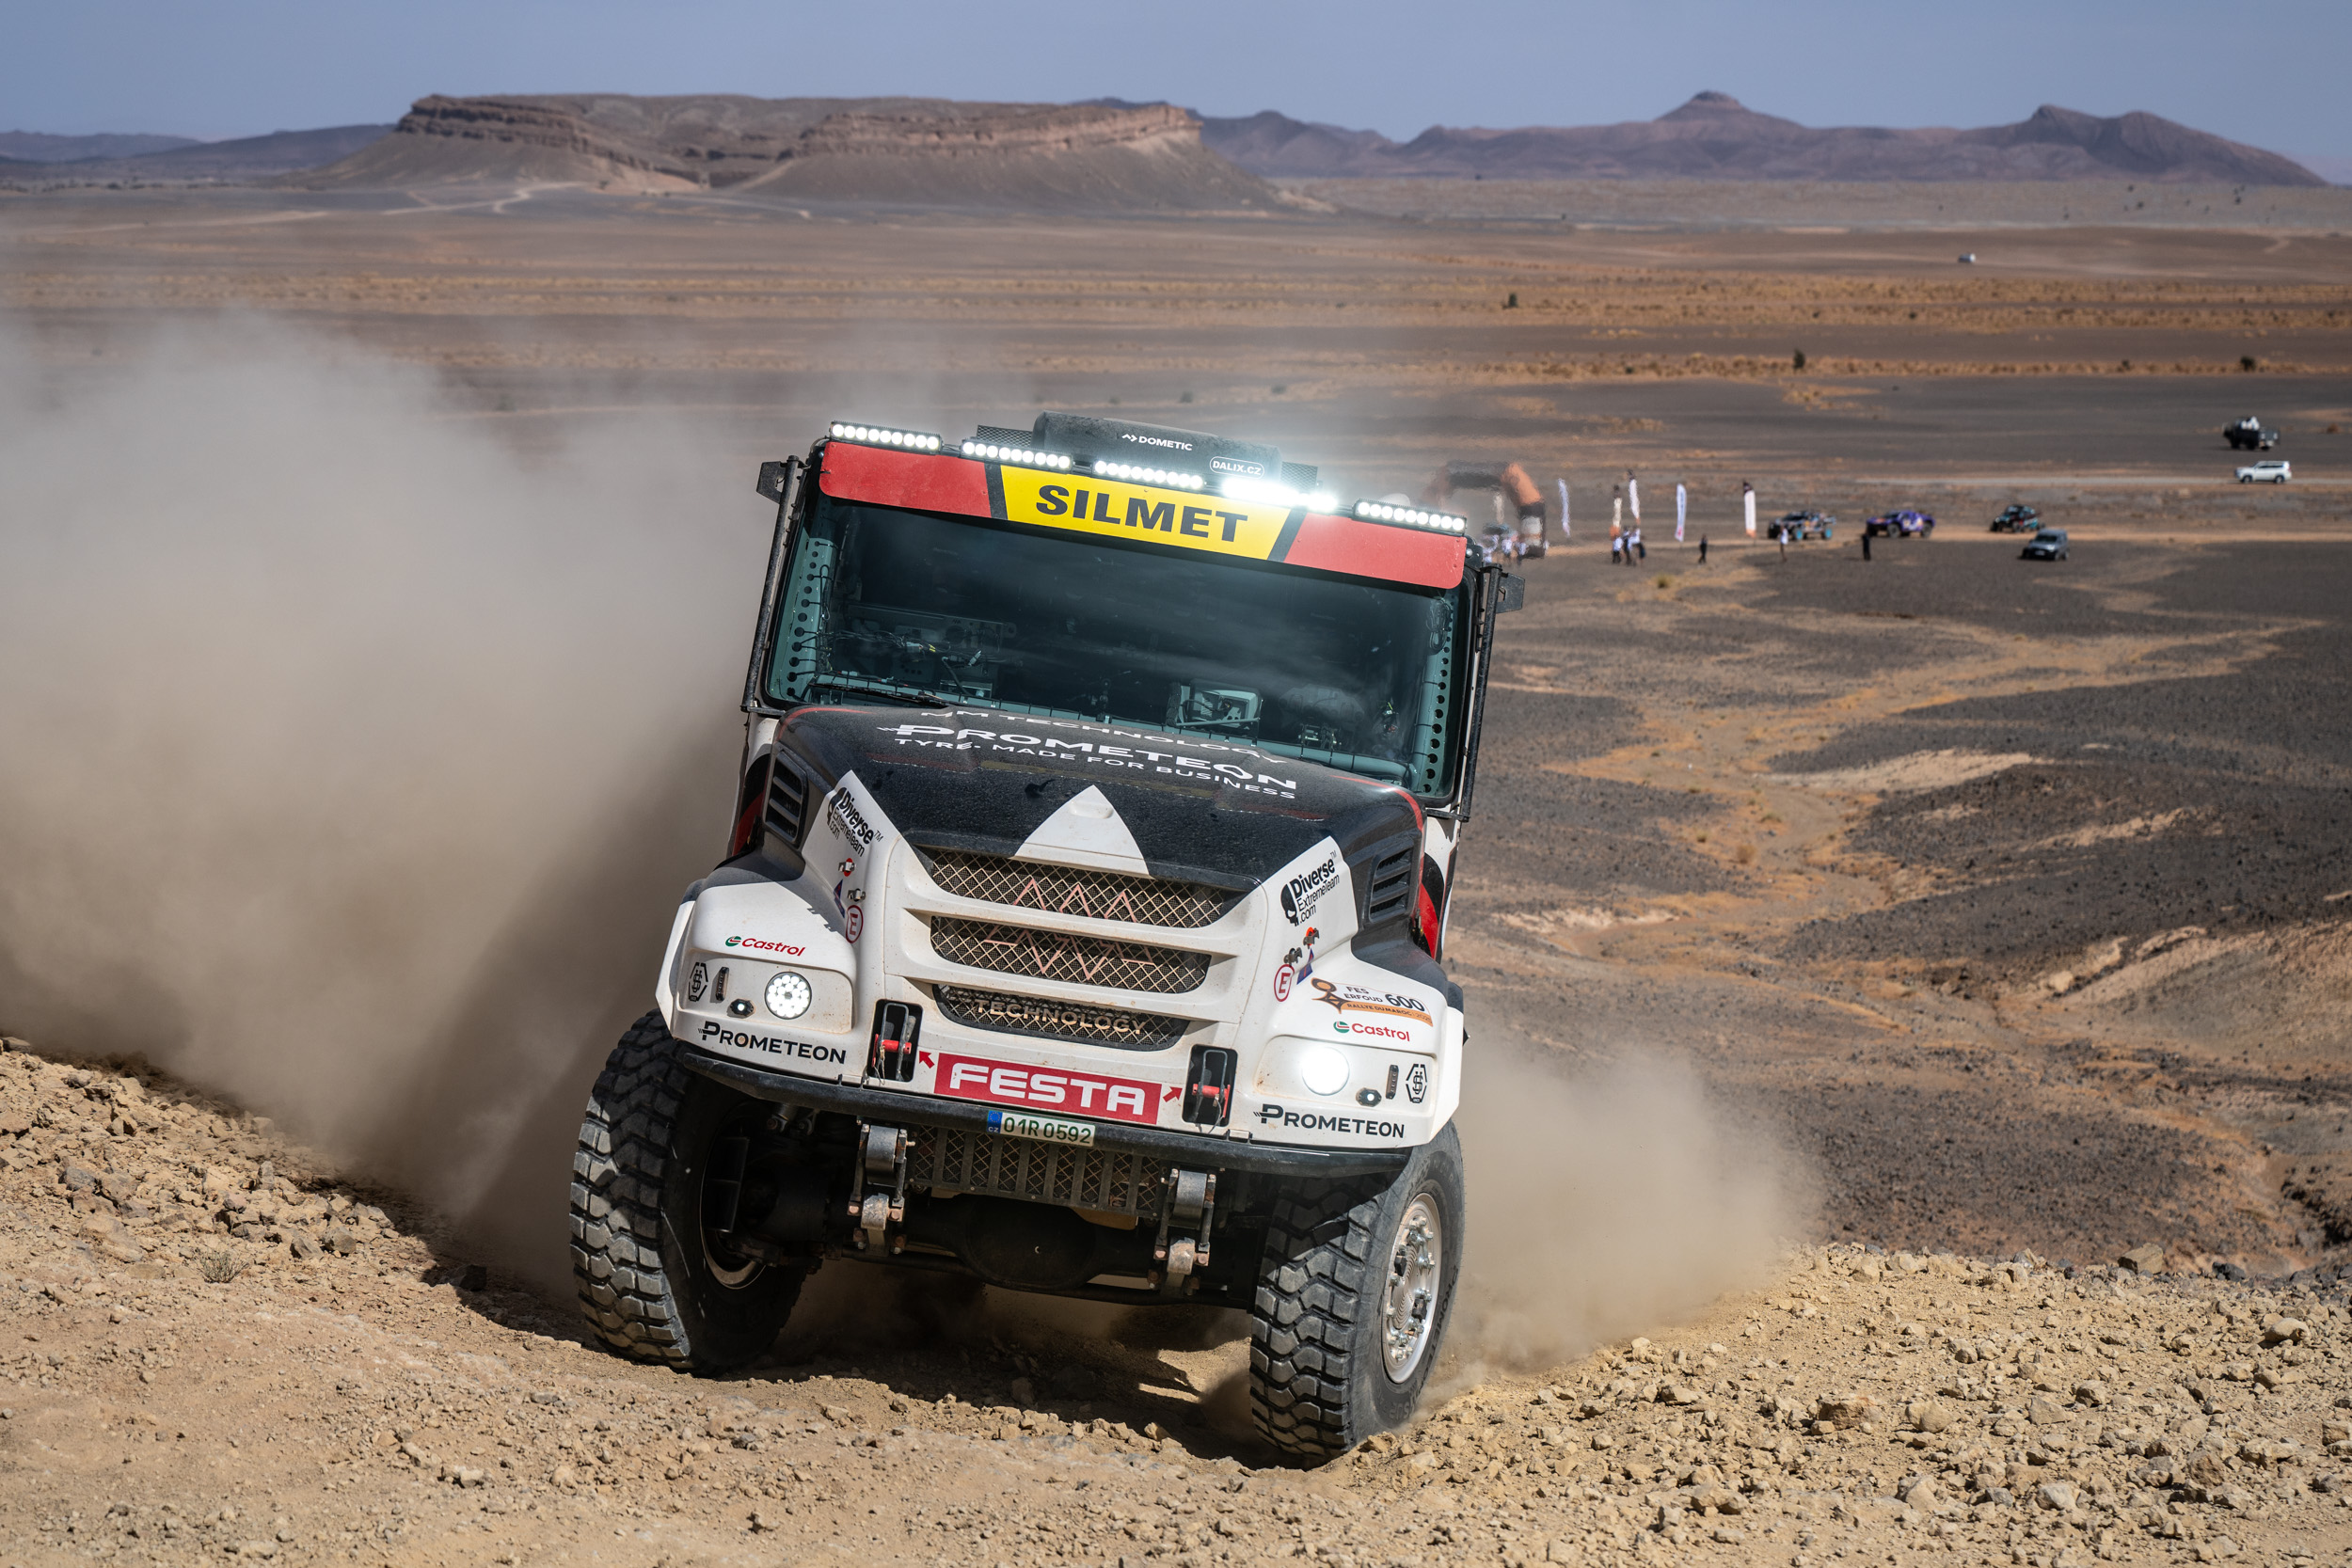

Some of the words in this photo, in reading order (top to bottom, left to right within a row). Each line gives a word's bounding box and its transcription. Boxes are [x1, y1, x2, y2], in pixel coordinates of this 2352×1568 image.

[1138, 436, 1193, 451] DOMETIC
[1212, 459, 1263, 477] DALIX.CZ
[1036, 484, 1248, 543] SILMET
[886, 724, 1296, 789] PROMETEON
[998, 714, 1287, 764] TECHNOLOGY
[993, 744, 1075, 763] MADE
[1087, 756, 1145, 770] FOR
[1156, 766, 1296, 800] BUSINESS
[837, 791, 875, 845] Diverse
[1289, 858, 1336, 899] Diverse
[1295, 874, 1341, 912] ExtremeTeam
[1299, 904, 1317, 924] .com
[741, 938, 806, 957] Castrol
[1278, 972, 1291, 994] E
[1343, 993, 1384, 1003] ERFOUD
[1345, 986, 1370, 994] FES
[973, 999, 1147, 1035] TECHNOLOGY
[1385, 993, 1425, 1012] 600
[698, 1021, 847, 1064] PROMETEON
[1351, 1023, 1410, 1041] Castrol
[950, 1062, 1146, 1116] FESTA
[1003, 1117, 1040, 1138] 01R
[1042, 1121, 1092, 1145] 0592
[1254, 1103, 1405, 1139] PROMETEON
